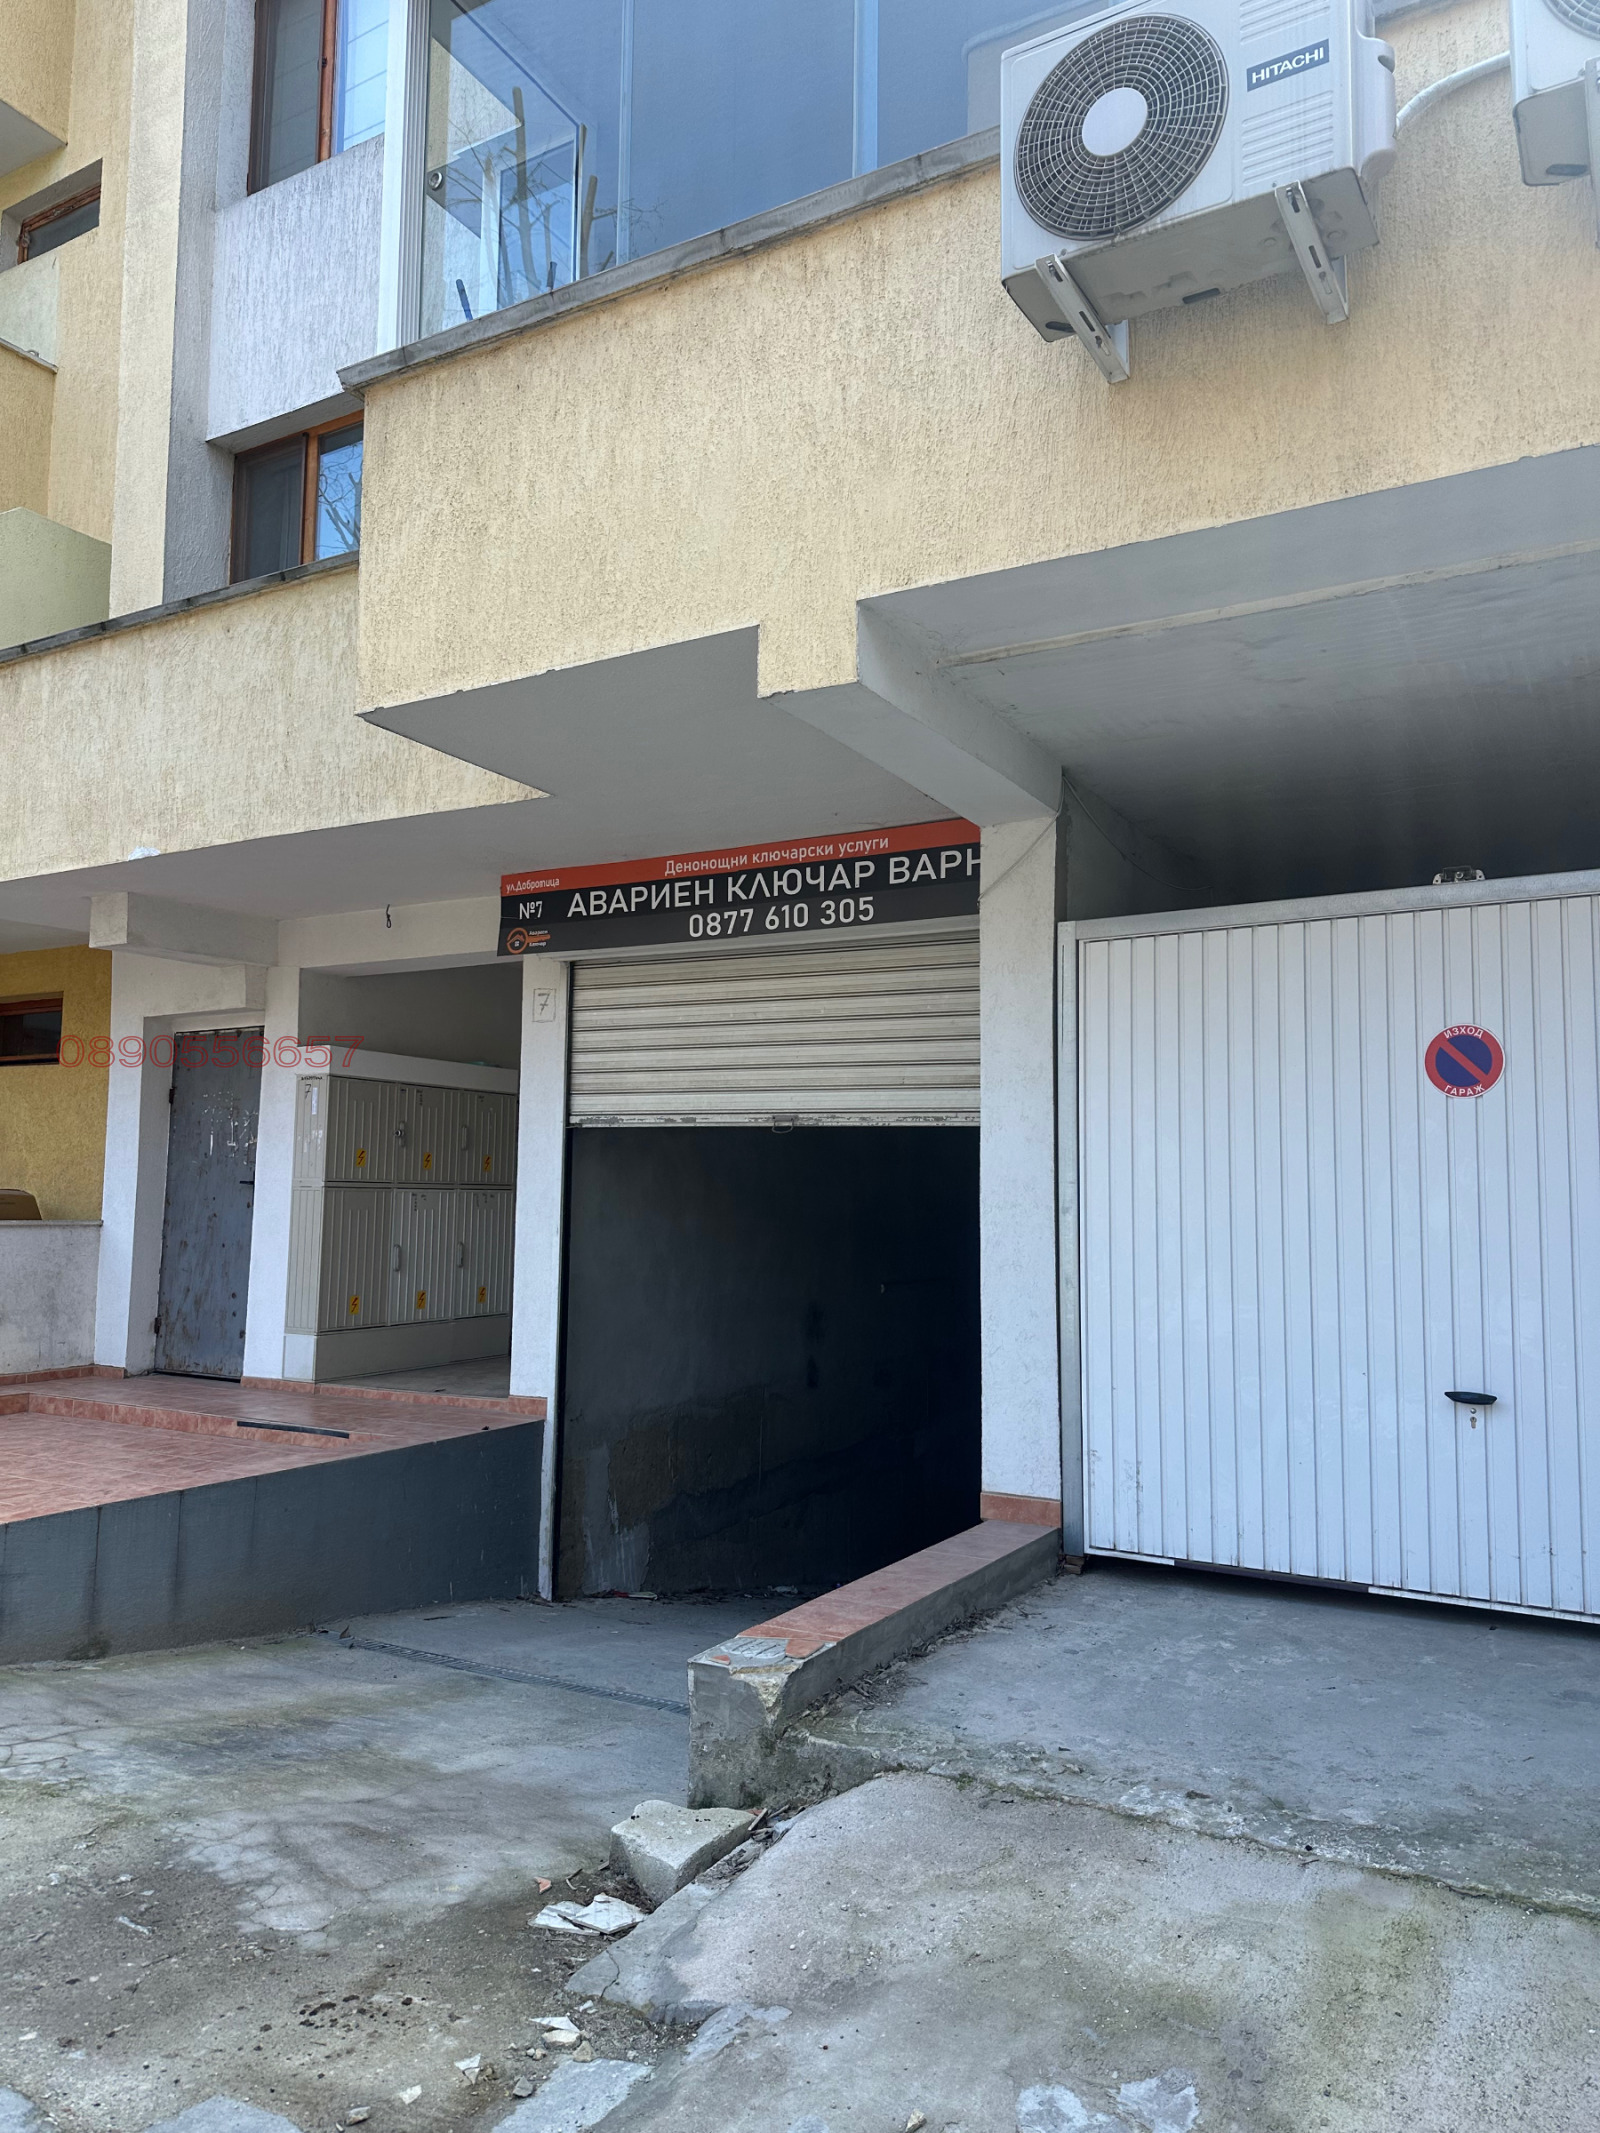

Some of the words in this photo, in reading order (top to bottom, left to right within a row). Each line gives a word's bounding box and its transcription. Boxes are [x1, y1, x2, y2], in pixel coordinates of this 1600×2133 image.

[1251, 46, 1325, 84] HITACHI
[664, 854, 748, 877] Денонощни
[752, 844, 834, 864] ключарски
[838, 837, 889, 857] услуги
[566, 878, 714, 918] АВАРИЕН
[727, 860, 876, 903] КЛЮЧАР
[519, 900, 543, 920] №7
[688, 908, 754, 938] 0877
[764, 902, 809, 931] 610
[819, 896, 875, 925] 305
[537, 992, 550, 1016] 7
[1443, 1026, 1484, 1039] ИЗХОД
[304, 1083, 312, 1100] 7
[1444, 1084, 1485, 1097] ГАРАЖ
